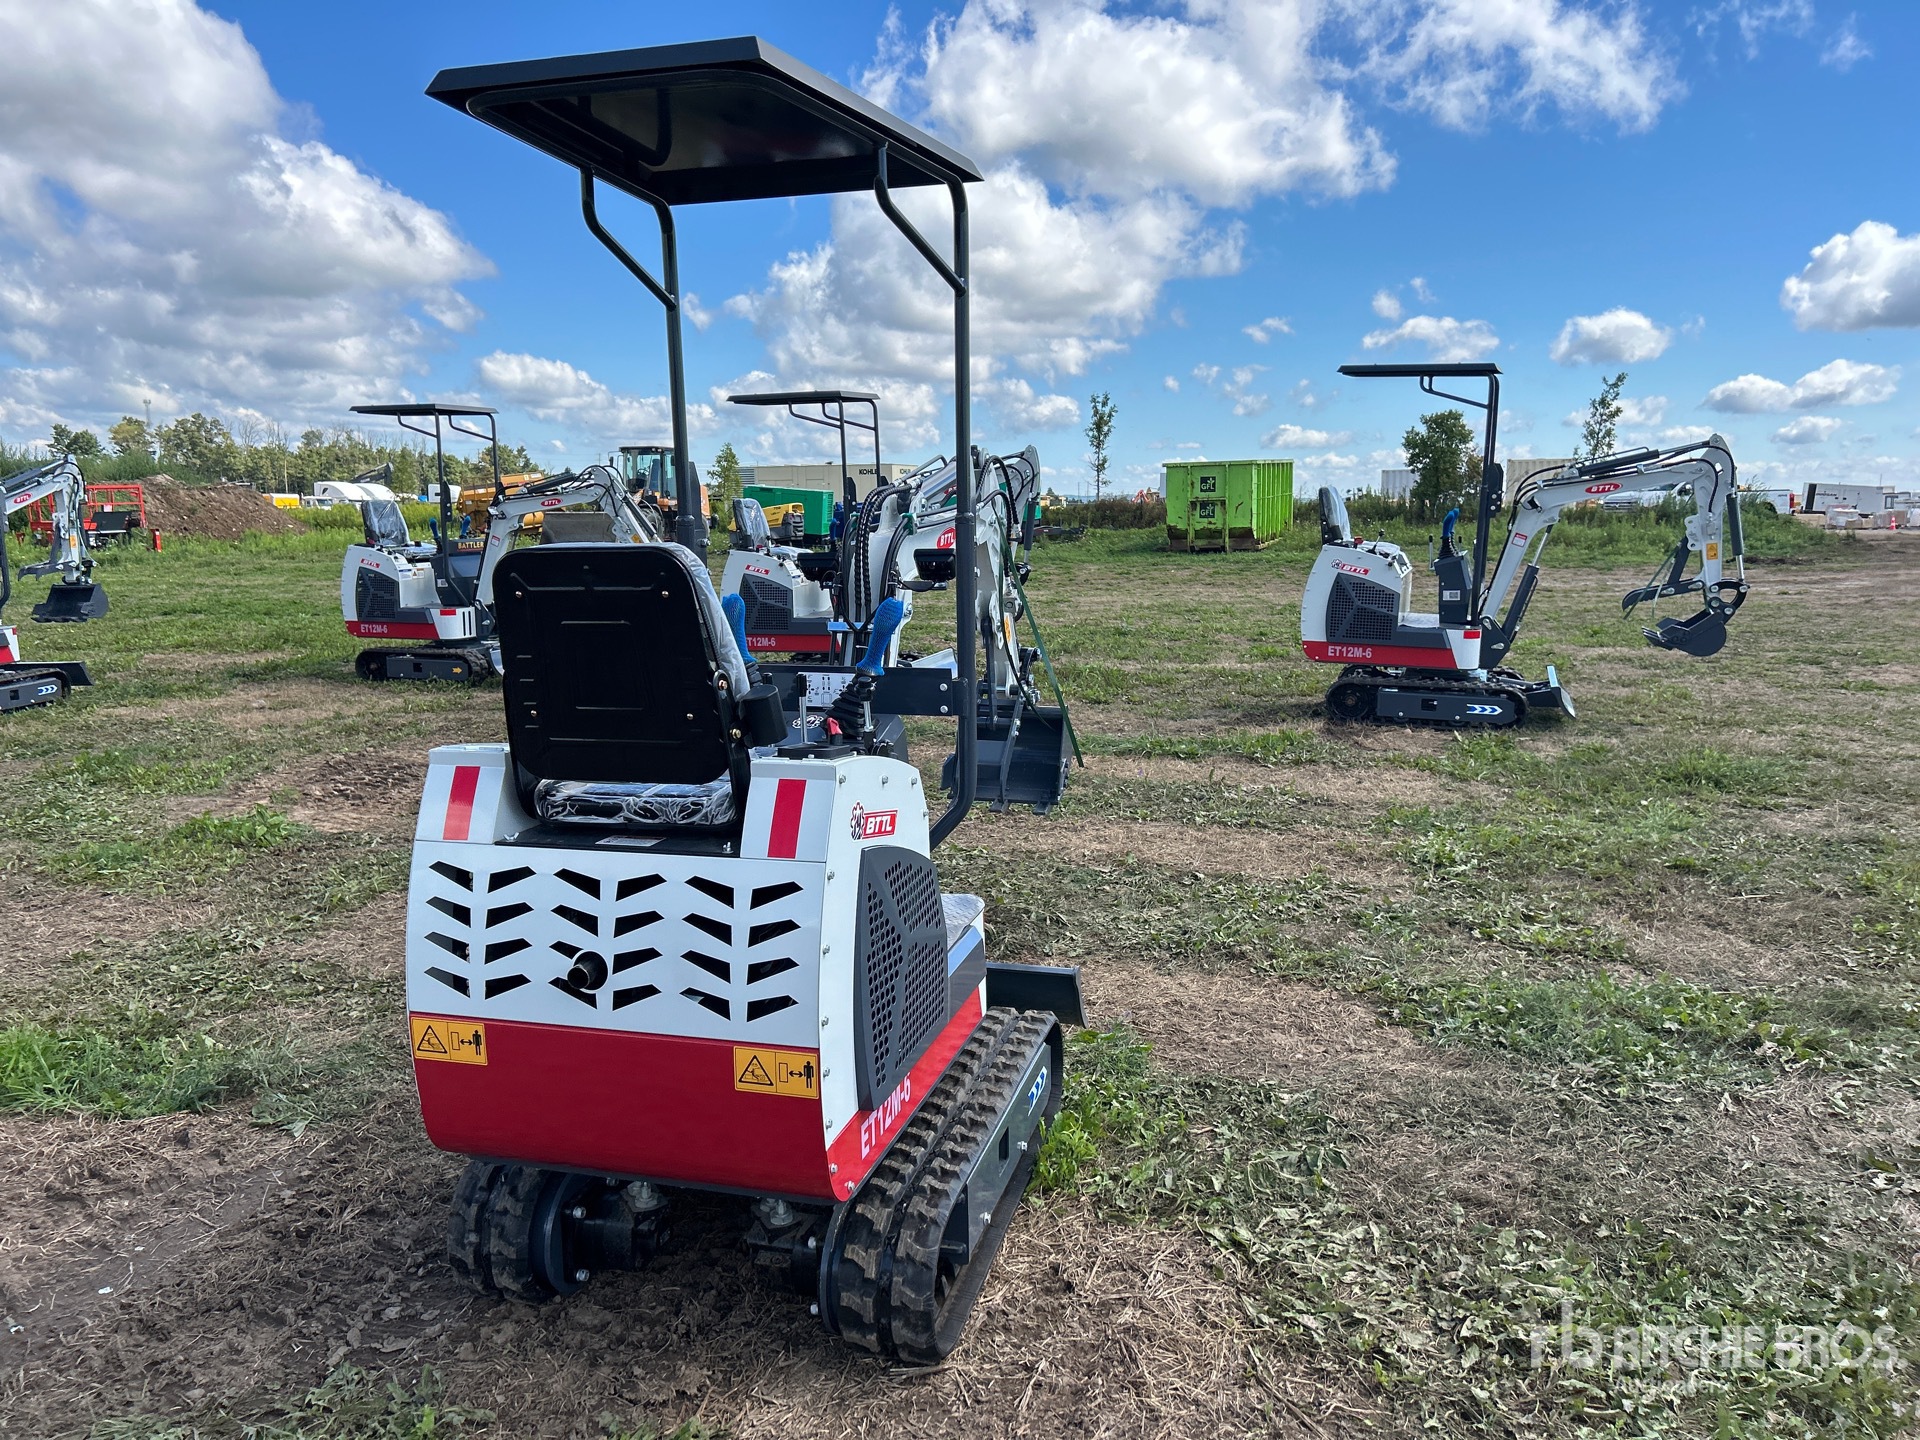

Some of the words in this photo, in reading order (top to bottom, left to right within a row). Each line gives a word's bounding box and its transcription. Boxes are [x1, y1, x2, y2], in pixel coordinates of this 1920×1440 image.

[749, 566, 767, 574] BTTL
[1342, 564, 1366, 574] BTTL
[361, 624, 388, 634] ET12M-6
[746, 637, 776, 646] T12M-6
[1327, 645, 1373, 659] ET12M-6
[865, 815, 893, 835] BTTL
[860, 1072, 912, 1161] ET12M-6
